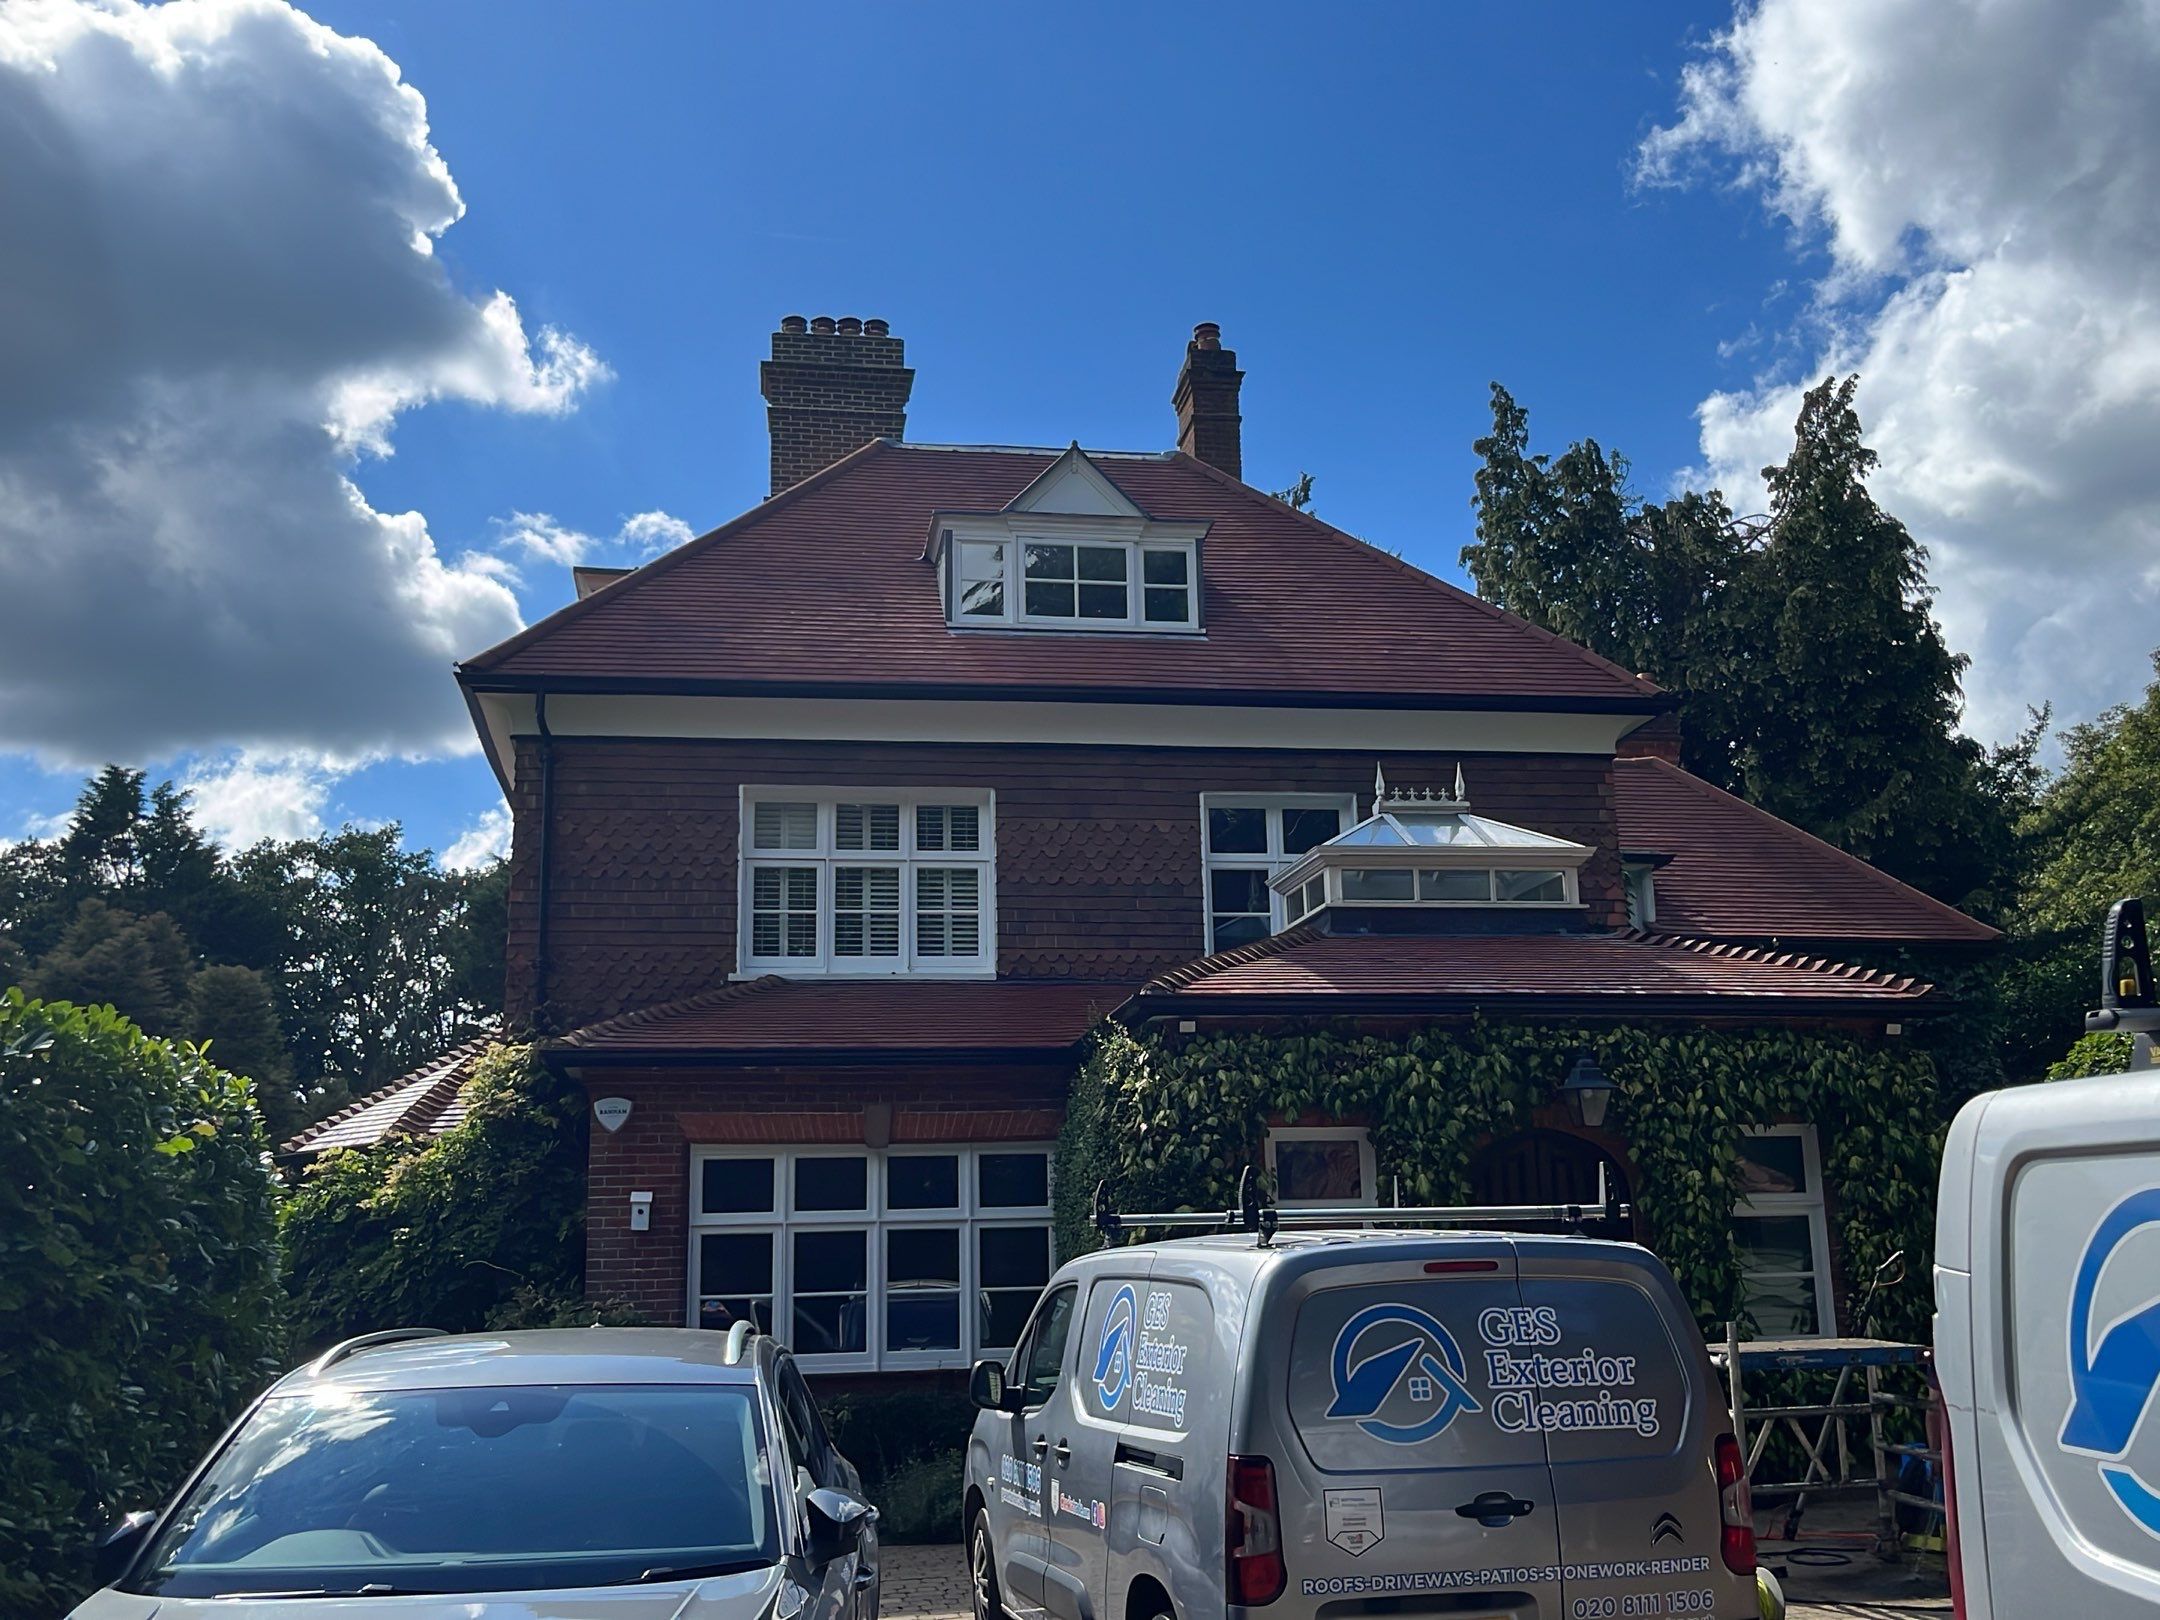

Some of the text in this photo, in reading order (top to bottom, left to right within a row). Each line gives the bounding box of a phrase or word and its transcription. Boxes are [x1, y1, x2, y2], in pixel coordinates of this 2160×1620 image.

[1143, 1292, 1172, 1331] GES
[1478, 1306, 1561, 1347] GES
[1136, 1332, 1187, 1375] Exterior
[1484, 1348, 1635, 1389] Exterior
[1132, 1371, 1187, 1428] Cleaning
[1491, 1390, 1660, 1437] Cleaning
[1573, 1590, 1715, 1619] 020 8111 1506
